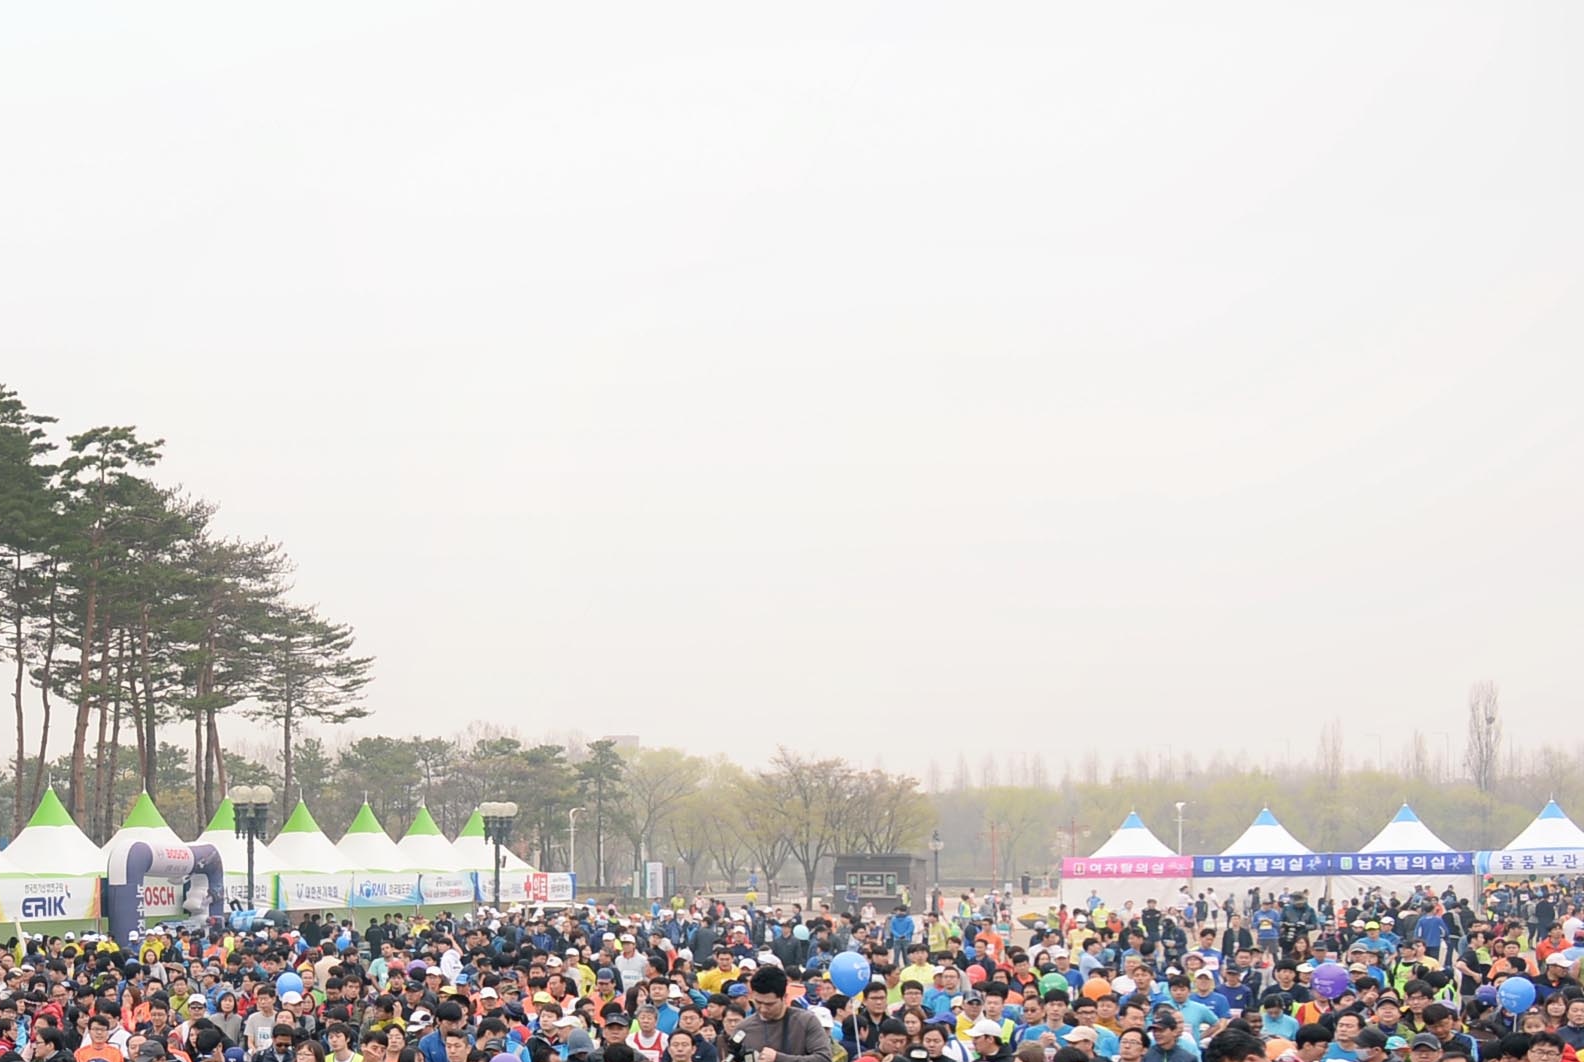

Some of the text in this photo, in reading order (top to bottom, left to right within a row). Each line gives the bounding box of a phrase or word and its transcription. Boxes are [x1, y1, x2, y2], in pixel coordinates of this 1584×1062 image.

[1089, 863, 1165, 875] 여자탈의실
[1219, 858, 1304, 873] 남자탈의실
[1357, 855, 1446, 871] 남자탈의실
[145, 886, 175, 906] OSCH
